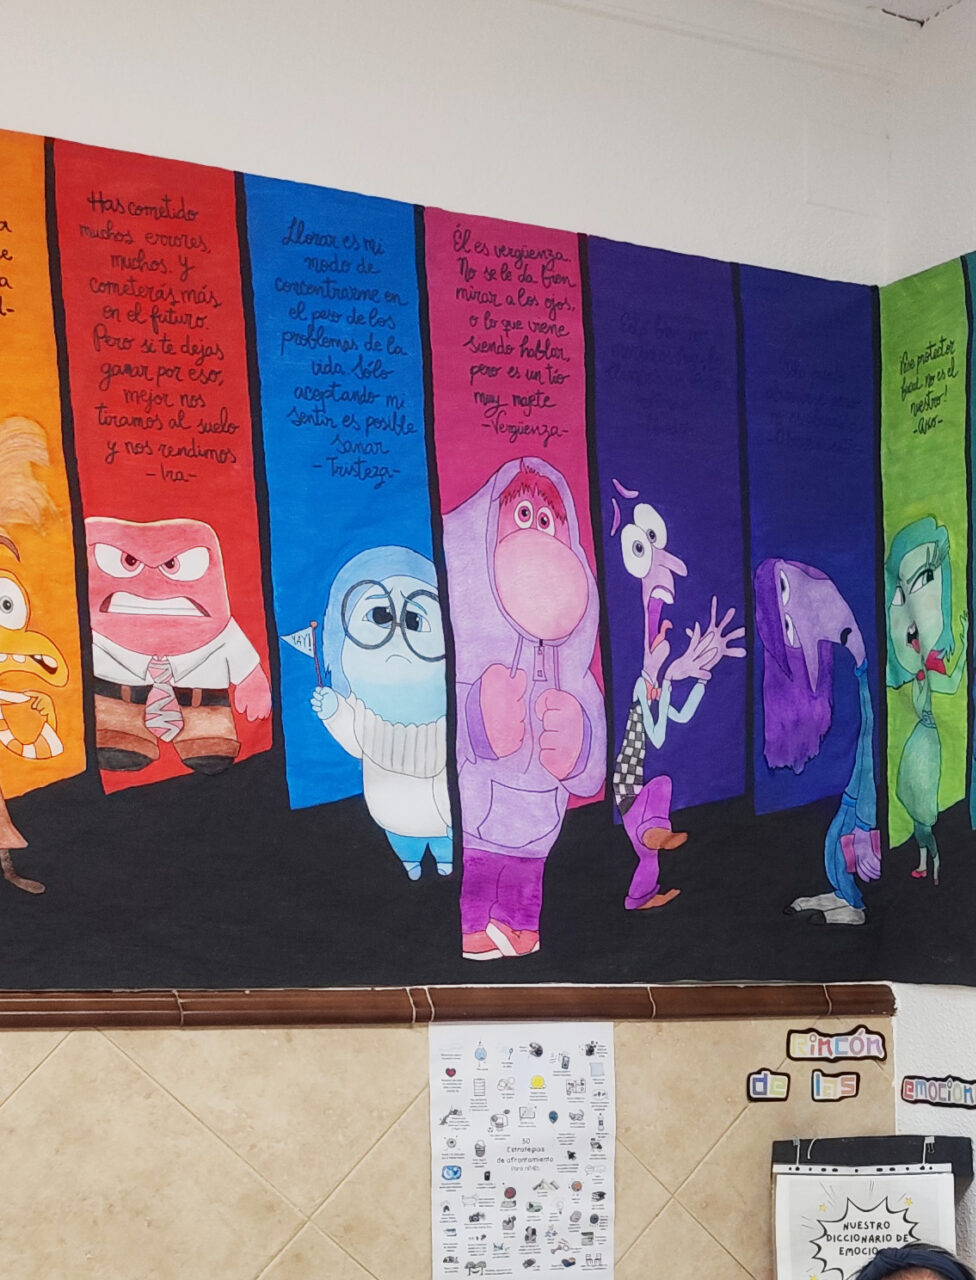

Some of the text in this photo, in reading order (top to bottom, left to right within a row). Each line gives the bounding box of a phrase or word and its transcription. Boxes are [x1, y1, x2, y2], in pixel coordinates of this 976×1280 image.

[843, 1220, 890, 1231] NUESTRO
[826, 1234, 909, 1244] DICCIONARIO DE
